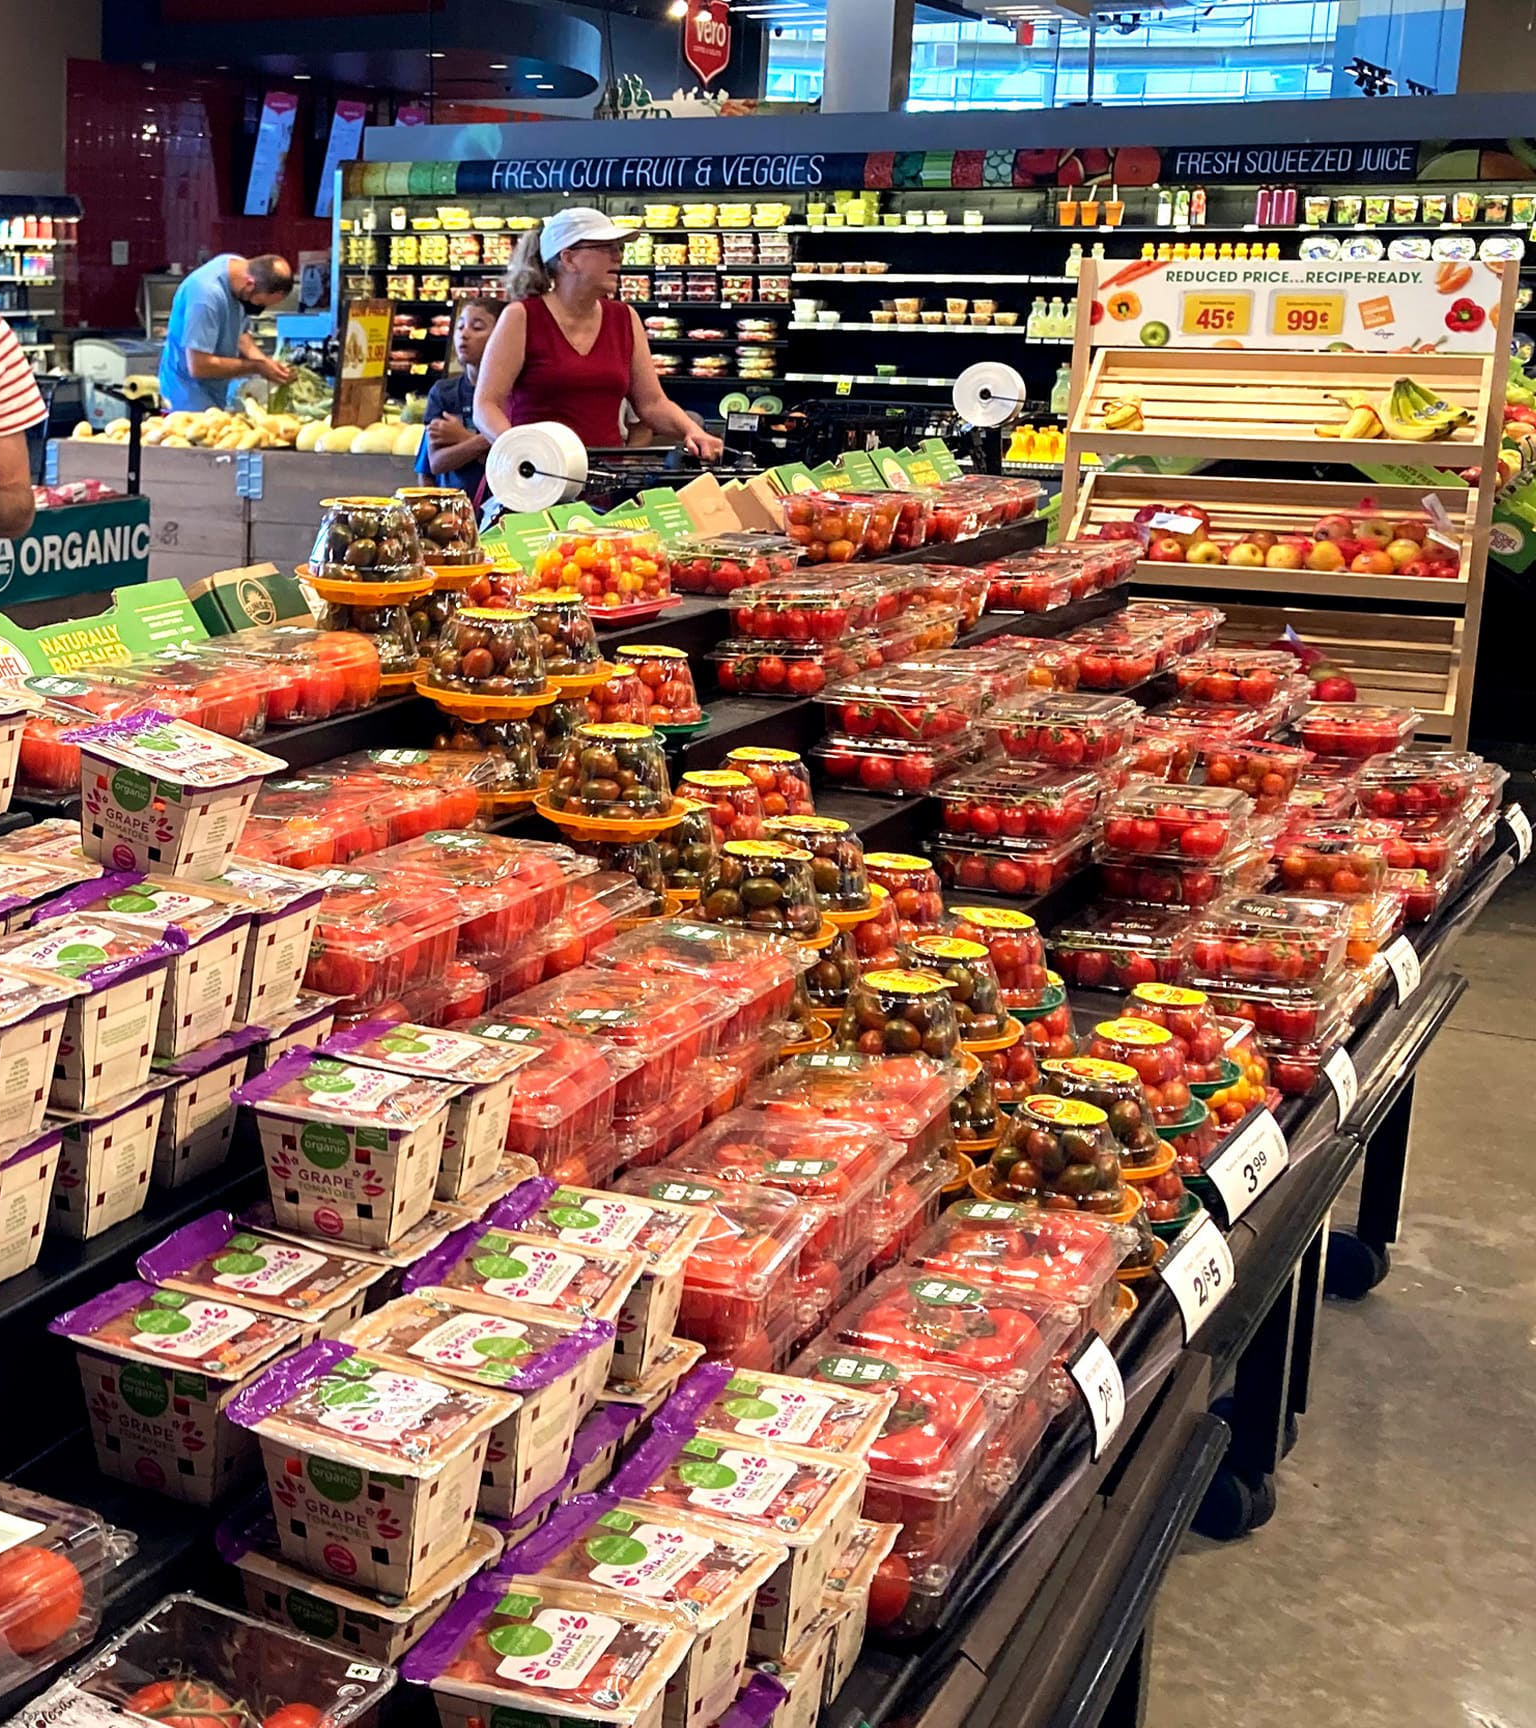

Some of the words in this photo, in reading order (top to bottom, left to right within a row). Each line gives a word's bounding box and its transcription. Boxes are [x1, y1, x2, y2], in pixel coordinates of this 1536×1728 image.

[491, 159, 567, 190] FRESH
[570, 158, 619, 189] CUT
[622, 157, 692, 188] FRUIT
[695, 156, 712, 187] &
[723, 154, 825, 187] VEGGIES
[1176, 151, 1239, 175] FRESH
[1245, 148, 1352, 174] SQUEEZED
[1357, 147, 1414, 172] JUICE
[1165, 270, 1238, 285] REDUCED
[20, 524, 150, 577] ORGANIC
[38, 624, 121, 656] NATURALLY
[114, 780, 149, 803] organic
[105, 807, 150, 834] GRAPE
[304, 1139, 347, 1156] organic
[298, 1168, 354, 1190] GRAPE
[119, 1414, 174, 1442] GRAPE
[312, 1467, 360, 1489] organic
[732, 1468, 764, 1499] GRAPE
[305, 1498, 369, 1530] GRAPE
[636, 1544, 677, 1578] GRAPE
[546, 1631, 583, 1668] GRAPE
